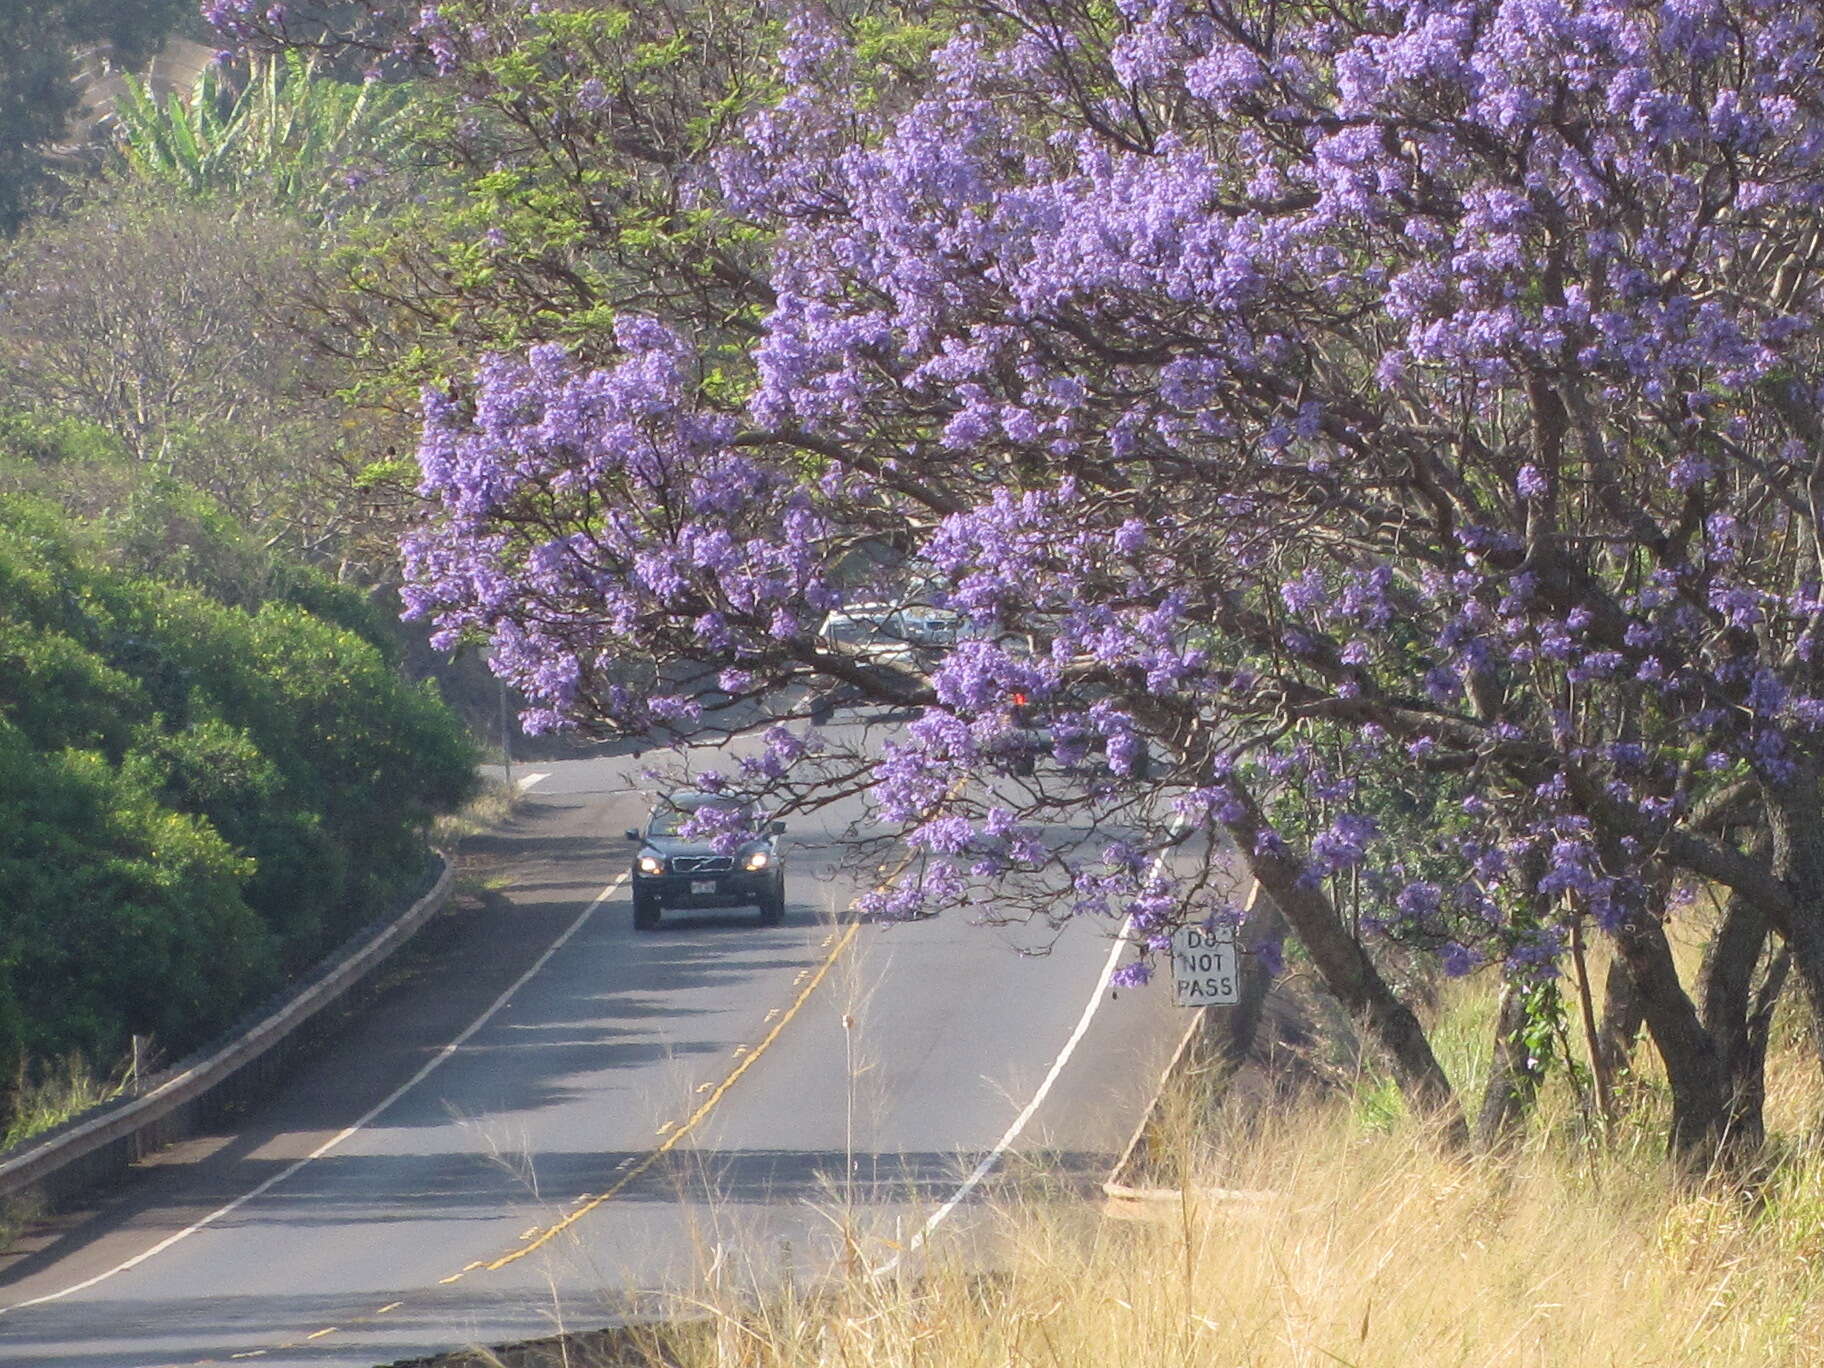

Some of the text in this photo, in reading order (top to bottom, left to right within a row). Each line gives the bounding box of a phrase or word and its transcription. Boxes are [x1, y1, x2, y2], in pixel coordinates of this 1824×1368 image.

[1188, 931, 1217, 948] DO
[1183, 954, 1223, 972] NOT
[1178, 977, 1232, 997] PASS
